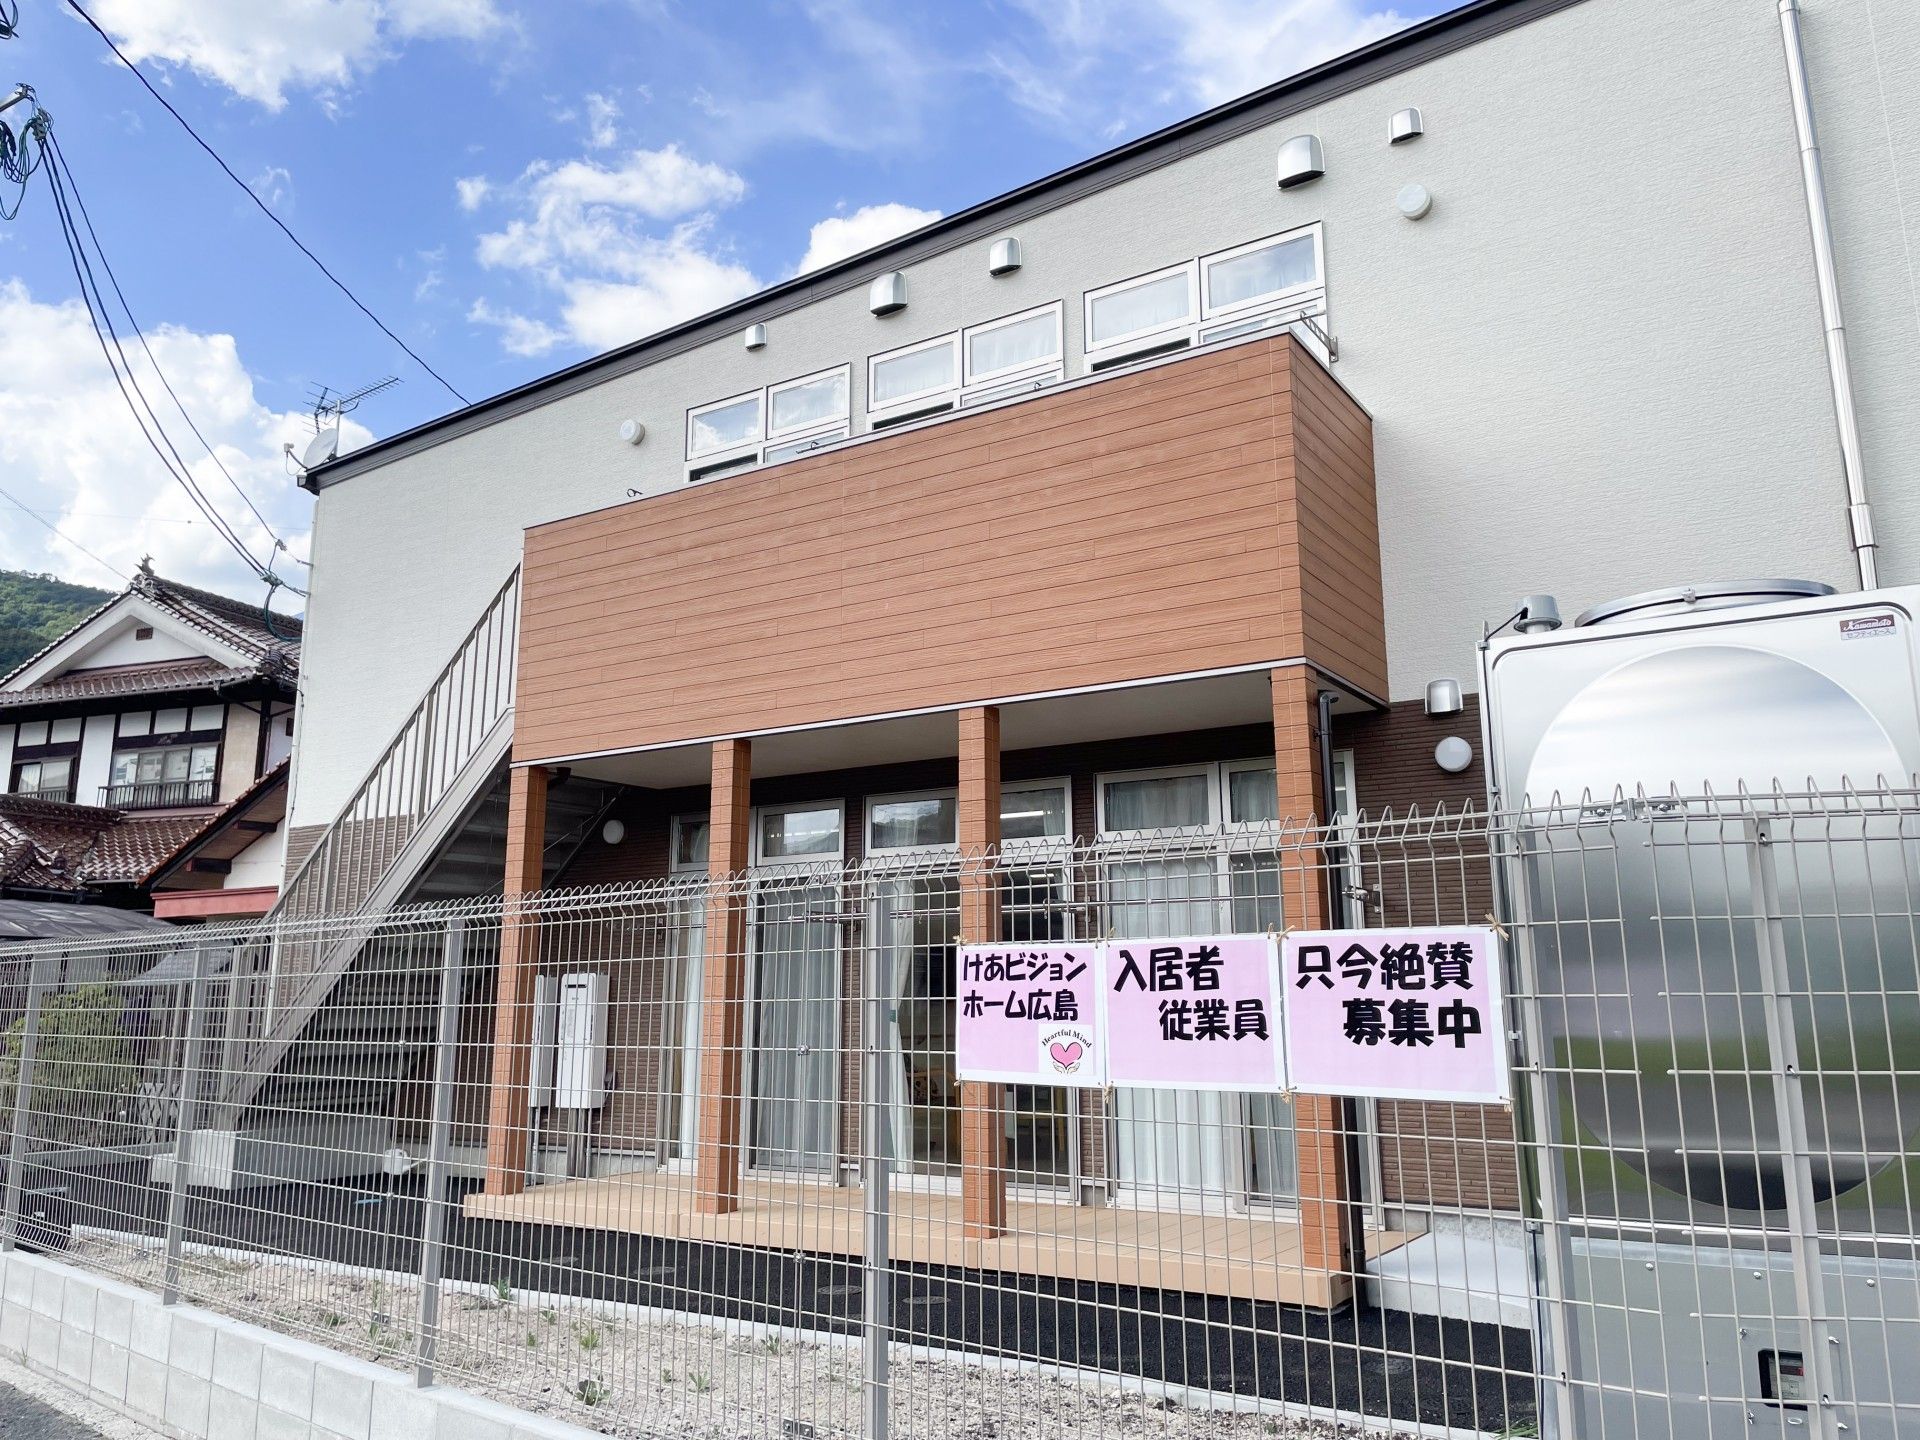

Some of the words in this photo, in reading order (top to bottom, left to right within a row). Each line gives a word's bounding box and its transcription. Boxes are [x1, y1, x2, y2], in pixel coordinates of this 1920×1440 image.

[1843, 618, 1892, 631] Kawamoto
[964, 953, 1086, 982] けあビジョン
[1114, 946, 1224, 992] 入居者
[1296, 942, 1473, 990] 只今絶賛
[964, 989, 1078, 1021] ホーム広島
[1159, 999, 1269, 1041] 従業員
[1343, 998, 1481, 1048] 募集中
[1042, 1029, 1071, 1046] Heartful
[1072, 1030, 1092, 1048] Mind
